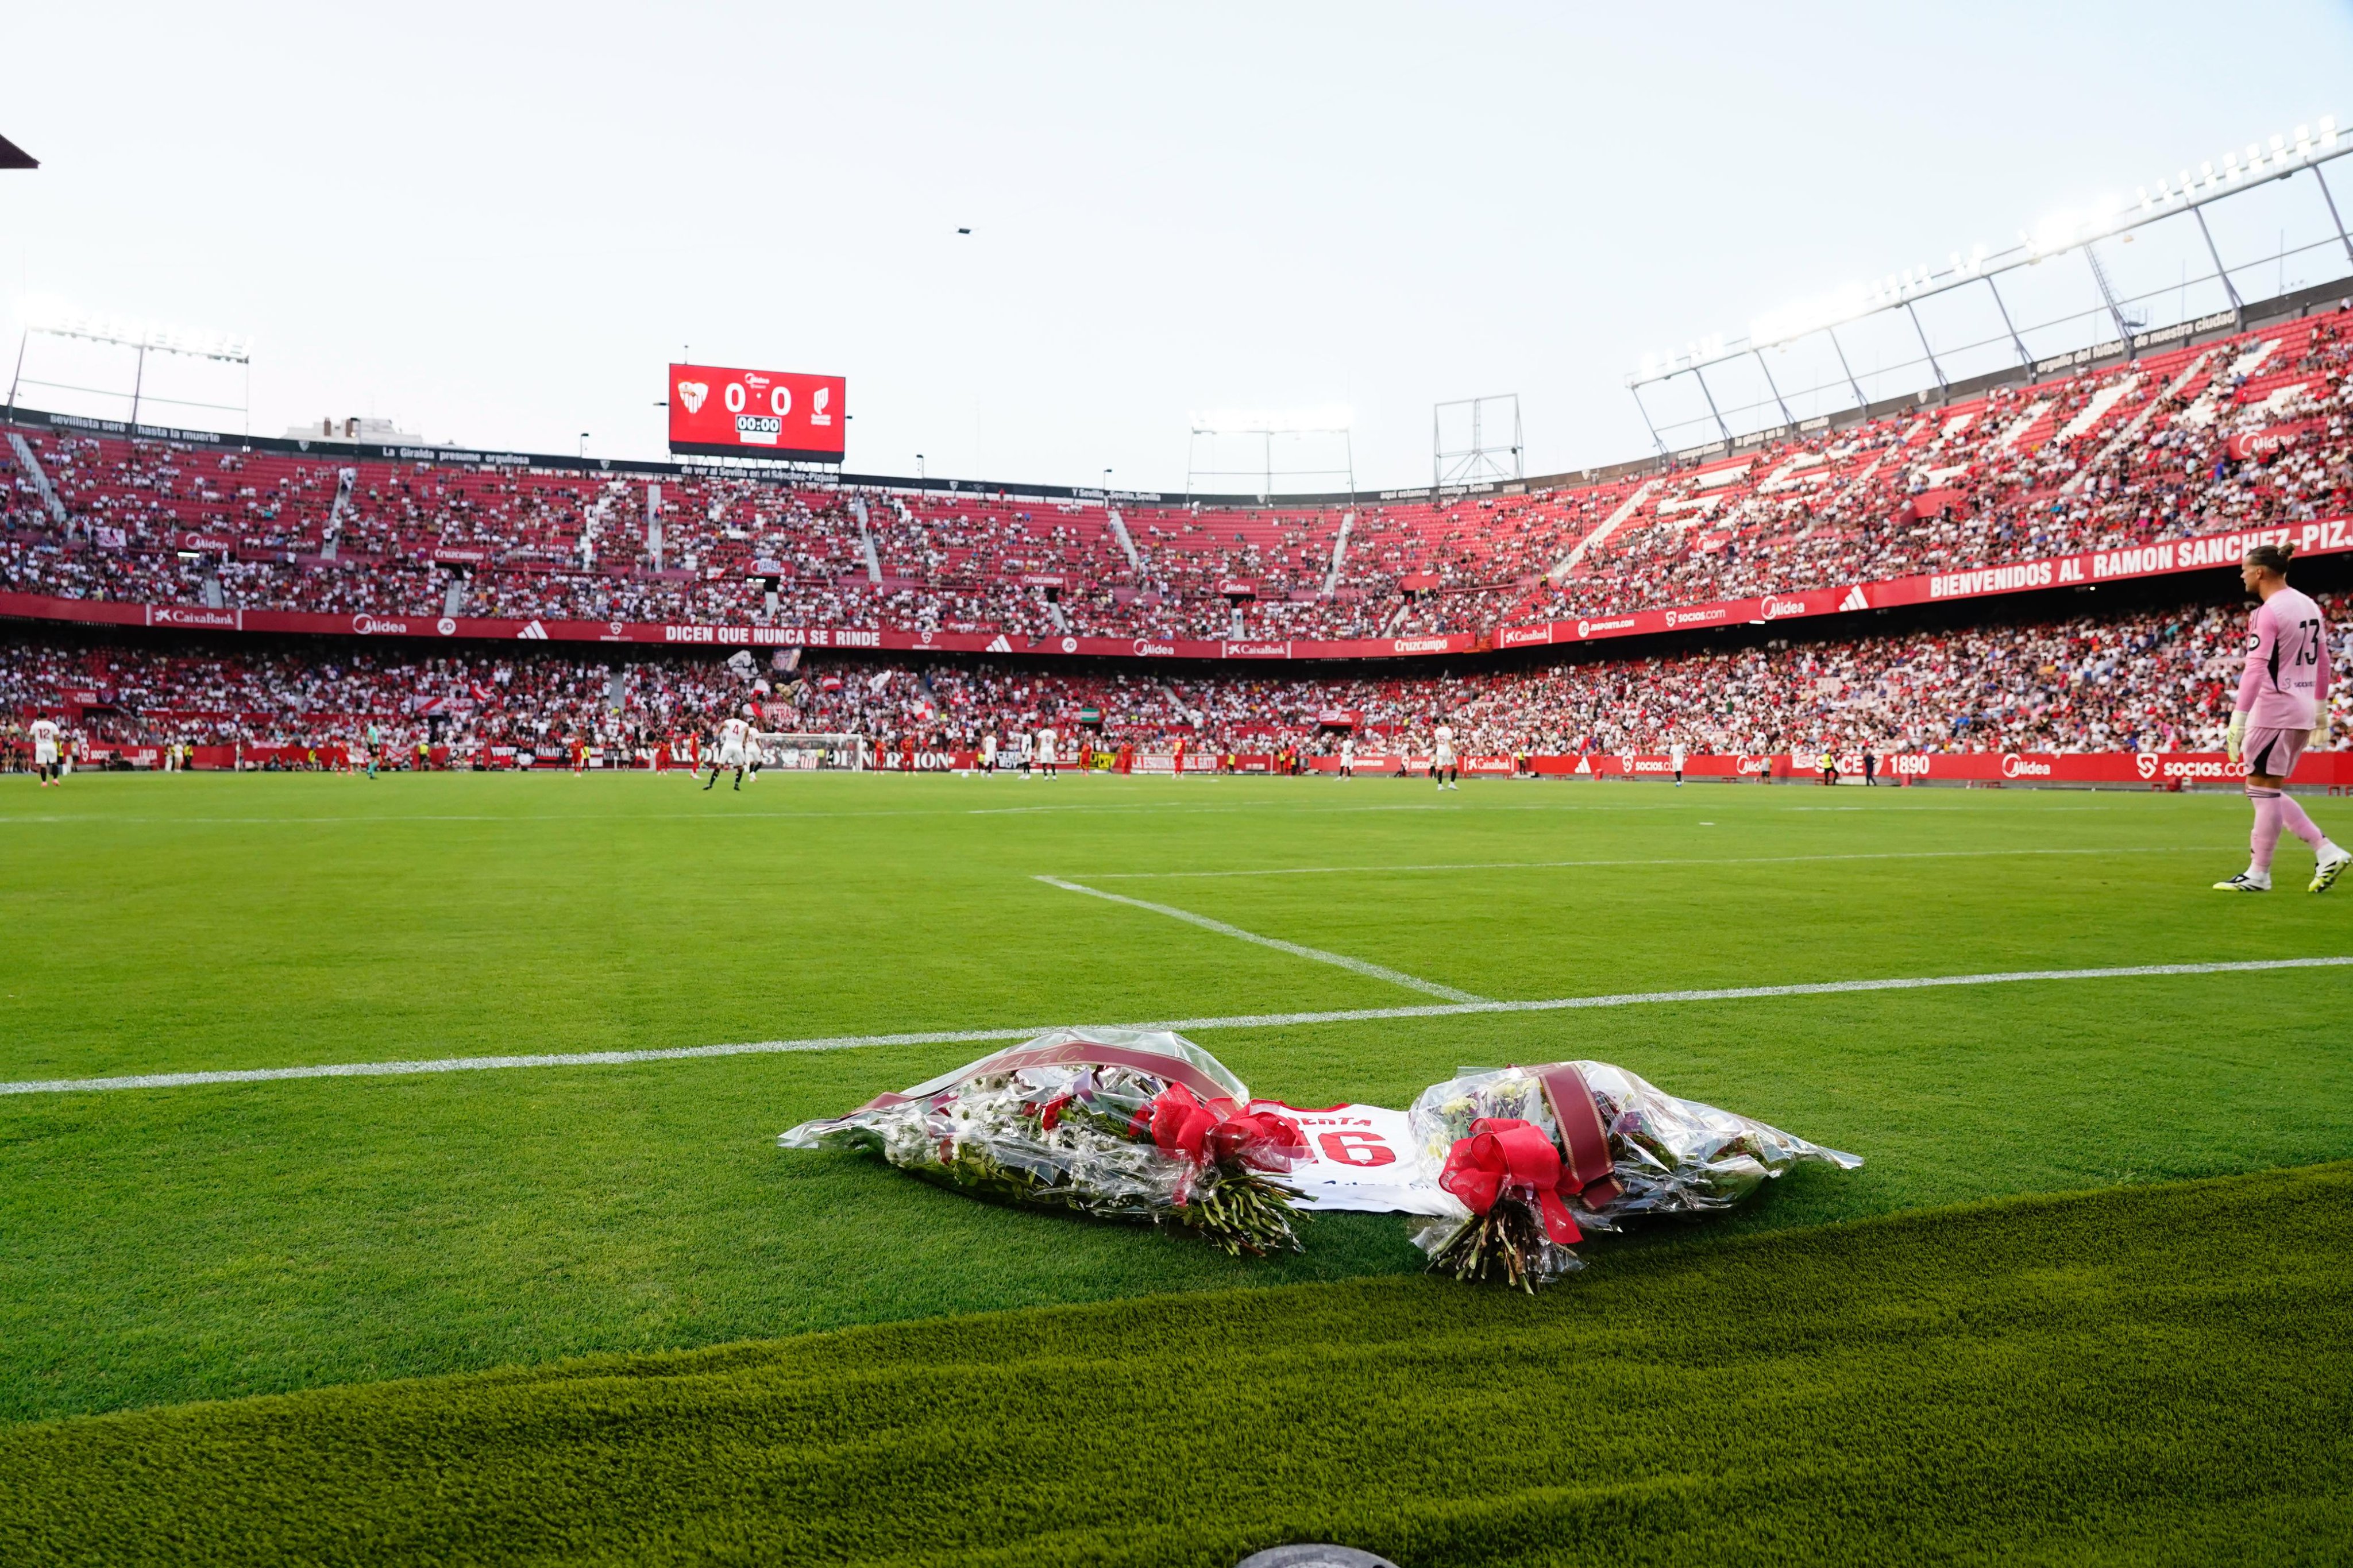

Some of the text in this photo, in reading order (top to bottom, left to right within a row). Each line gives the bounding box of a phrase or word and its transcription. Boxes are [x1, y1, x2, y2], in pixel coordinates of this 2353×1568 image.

[2037, 353, 2073, 373] orgullo
[2074, 349, 2090, 363] del
[2134, 334, 2148, 347] de
[2150, 322, 2193, 343] nuestra
[2195, 311, 2236, 332] ciudad
[725, 383, 792, 416] 0 0
[50, 414, 99, 429] sevillista
[138, 424, 167, 438] hasta
[170, 428, 180, 439] la
[183, 430, 220, 443] muerte
[738, 416, 779, 432] 00:00
[383, 447, 530, 465] La Giralda presume orgullosa
[681, 465, 692, 474] de
[694, 467, 707, 475] ver
[709, 466, 718, 476] al
[719, 467, 747, 477] Sevilla
[749, 470, 760, 478] en
[762, 469, 770, 478] el
[1398, 488, 1430, 497] estamos
[1439, 485, 1467, 495] contigo
[1469, 483, 1494, 493] Sevilla
[1930, 562, 2052, 598] BIENVENIDOS
[2058, 558, 2084, 582] AL
[2093, 544, 2174, 578] RAMON
[1765, 598, 1805, 619] Midea
[173, 610, 234, 625] CaixaBank
[357, 615, 407, 634] Midea
[666, 625, 880, 647] DICEN QUE NUNCA SE RINDE
[1515, 629, 1548, 642] CaixaBank
[2296, 619, 2320, 666] 13
[1137, 640, 1174, 655] Midea
[1241, 644, 1285, 655] CaixaBank
[1394, 638, 1448, 652] Cruzcampo
[38, 728, 50, 739] 12
[733, 725, 739, 735] 4
[1478, 758, 1510, 770] CaixaBank
[1890, 755, 1930, 774] 1890
[2006, 757, 2050, 777] Midea
